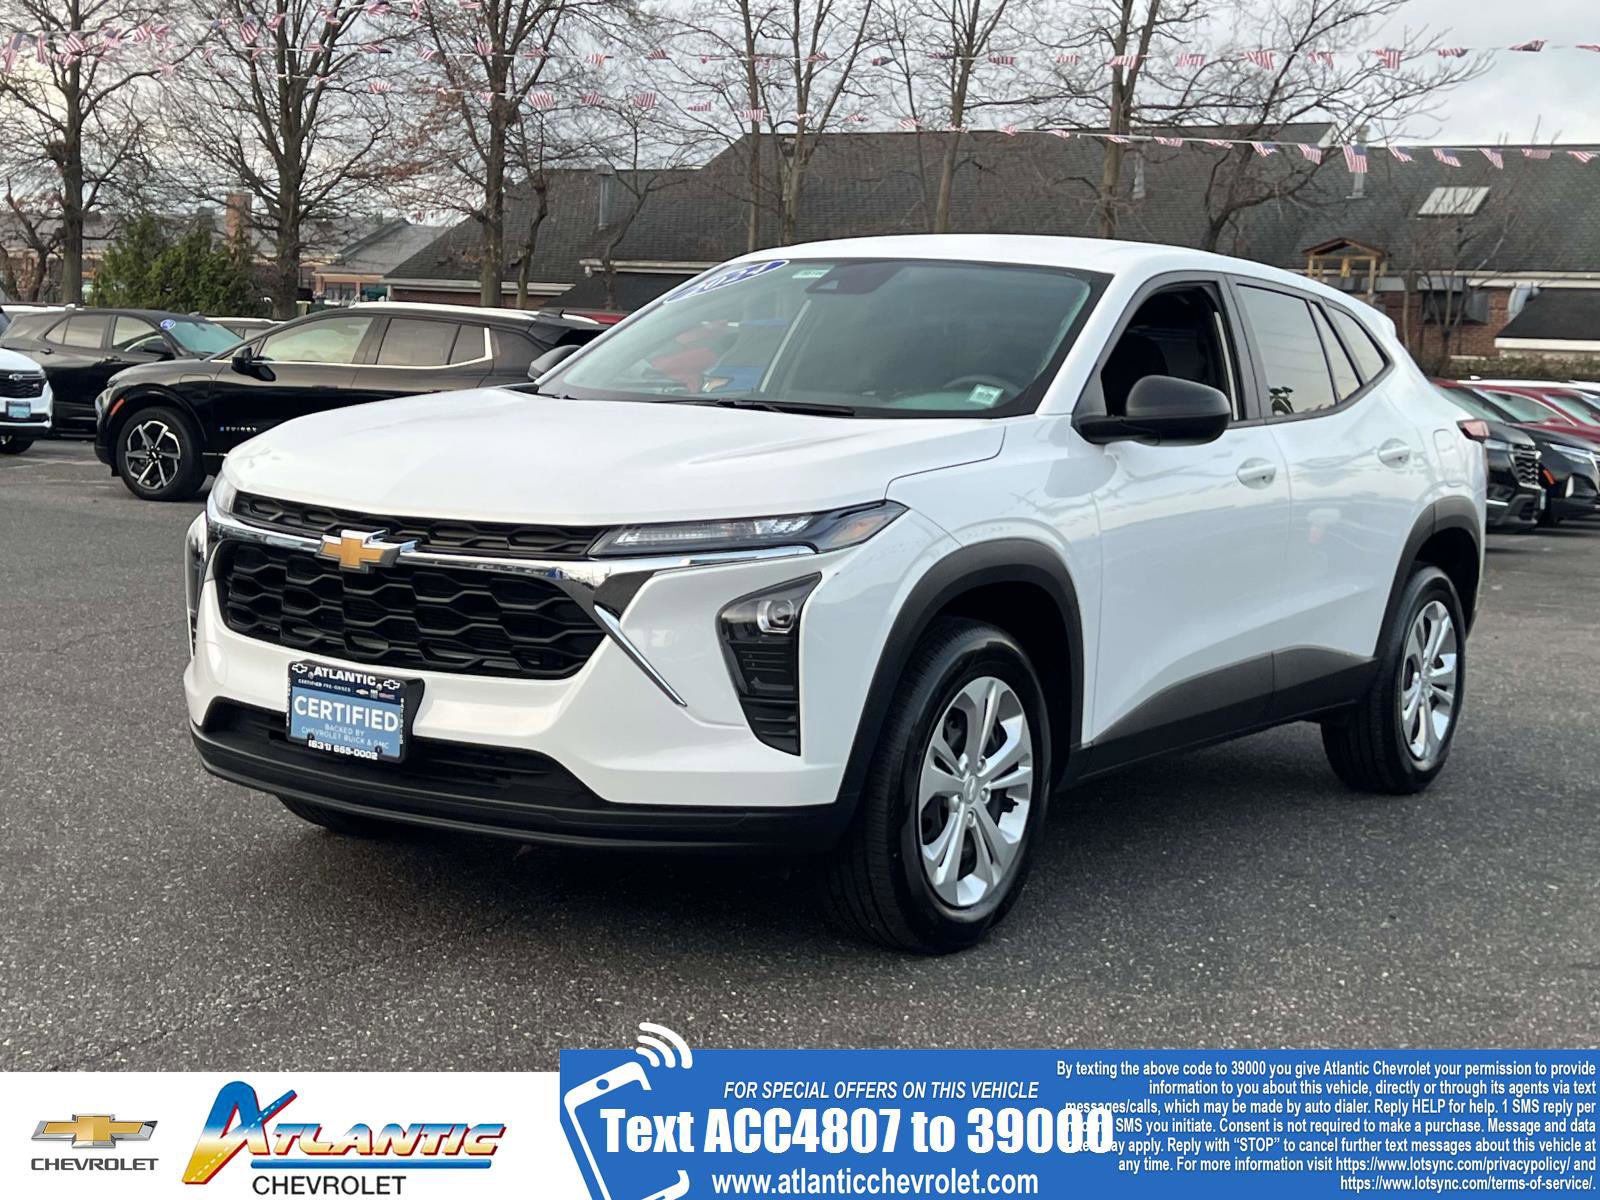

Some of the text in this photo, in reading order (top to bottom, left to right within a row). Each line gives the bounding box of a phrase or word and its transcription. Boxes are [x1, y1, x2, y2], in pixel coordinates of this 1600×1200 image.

[313, 666, 376, 686] ATLANTIC
[294, 695, 399, 732] CERTIFIED
[324, 723, 365, 737] BACKED BY
